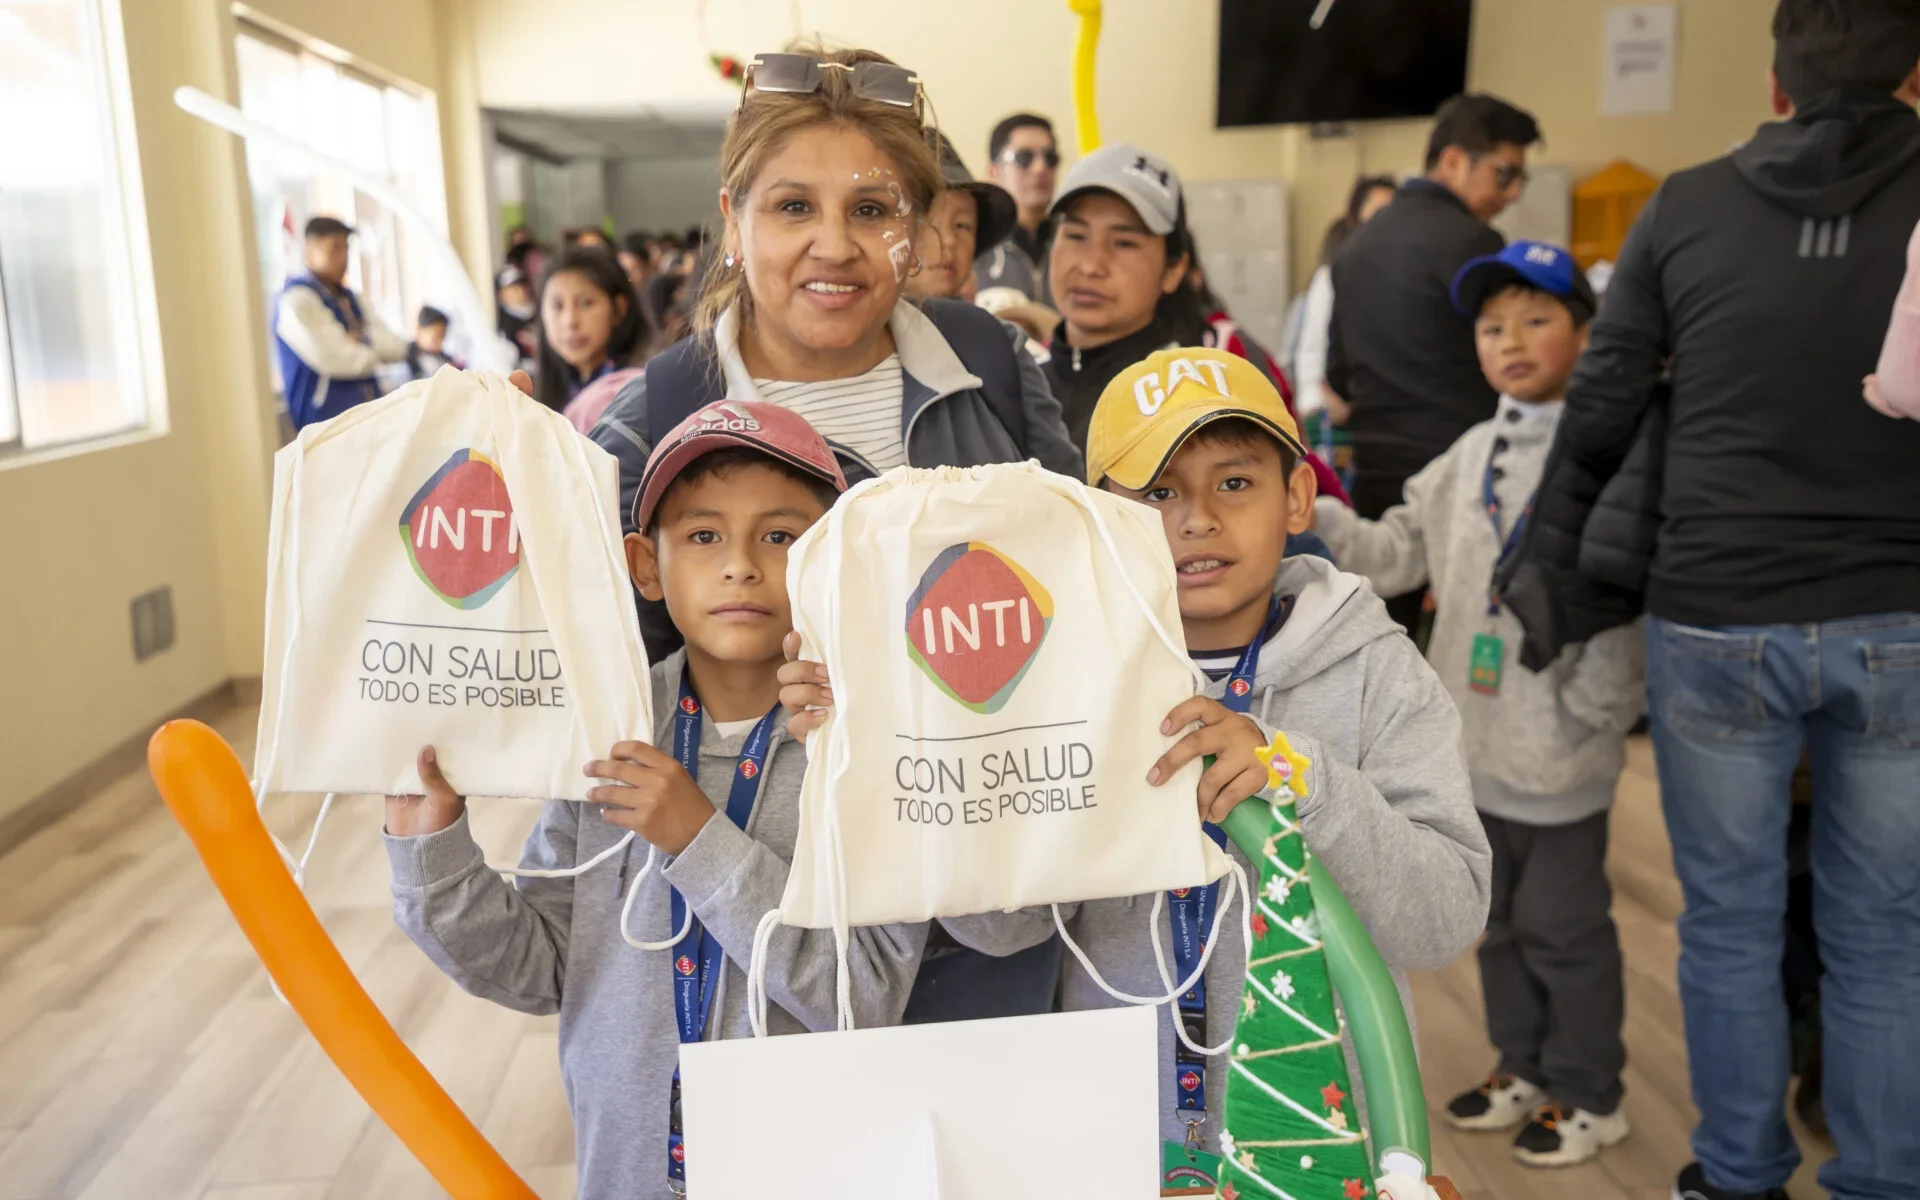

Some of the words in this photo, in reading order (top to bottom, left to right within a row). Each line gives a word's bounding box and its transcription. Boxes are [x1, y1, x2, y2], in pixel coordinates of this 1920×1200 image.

[1133, 358, 1230, 417] CAT
[416, 505, 519, 555] INTI
[922, 597, 1031, 655] INTI
[362, 639, 433, 676] CON
[448, 645, 562, 682] SALUD
[359, 677, 420, 703] TODO
[428, 683, 457, 707] ES
[465, 686, 565, 708] POSIBLE
[895, 755, 965, 794] CON
[981, 742, 1093, 790] SALUD
[893, 797, 953, 826] TODO
[963, 798, 993, 824] ES
[999, 784, 1098, 818] POSIBLE
[682, 957, 690, 975] INTI
[1181, 1077, 1198, 1086] INTI
